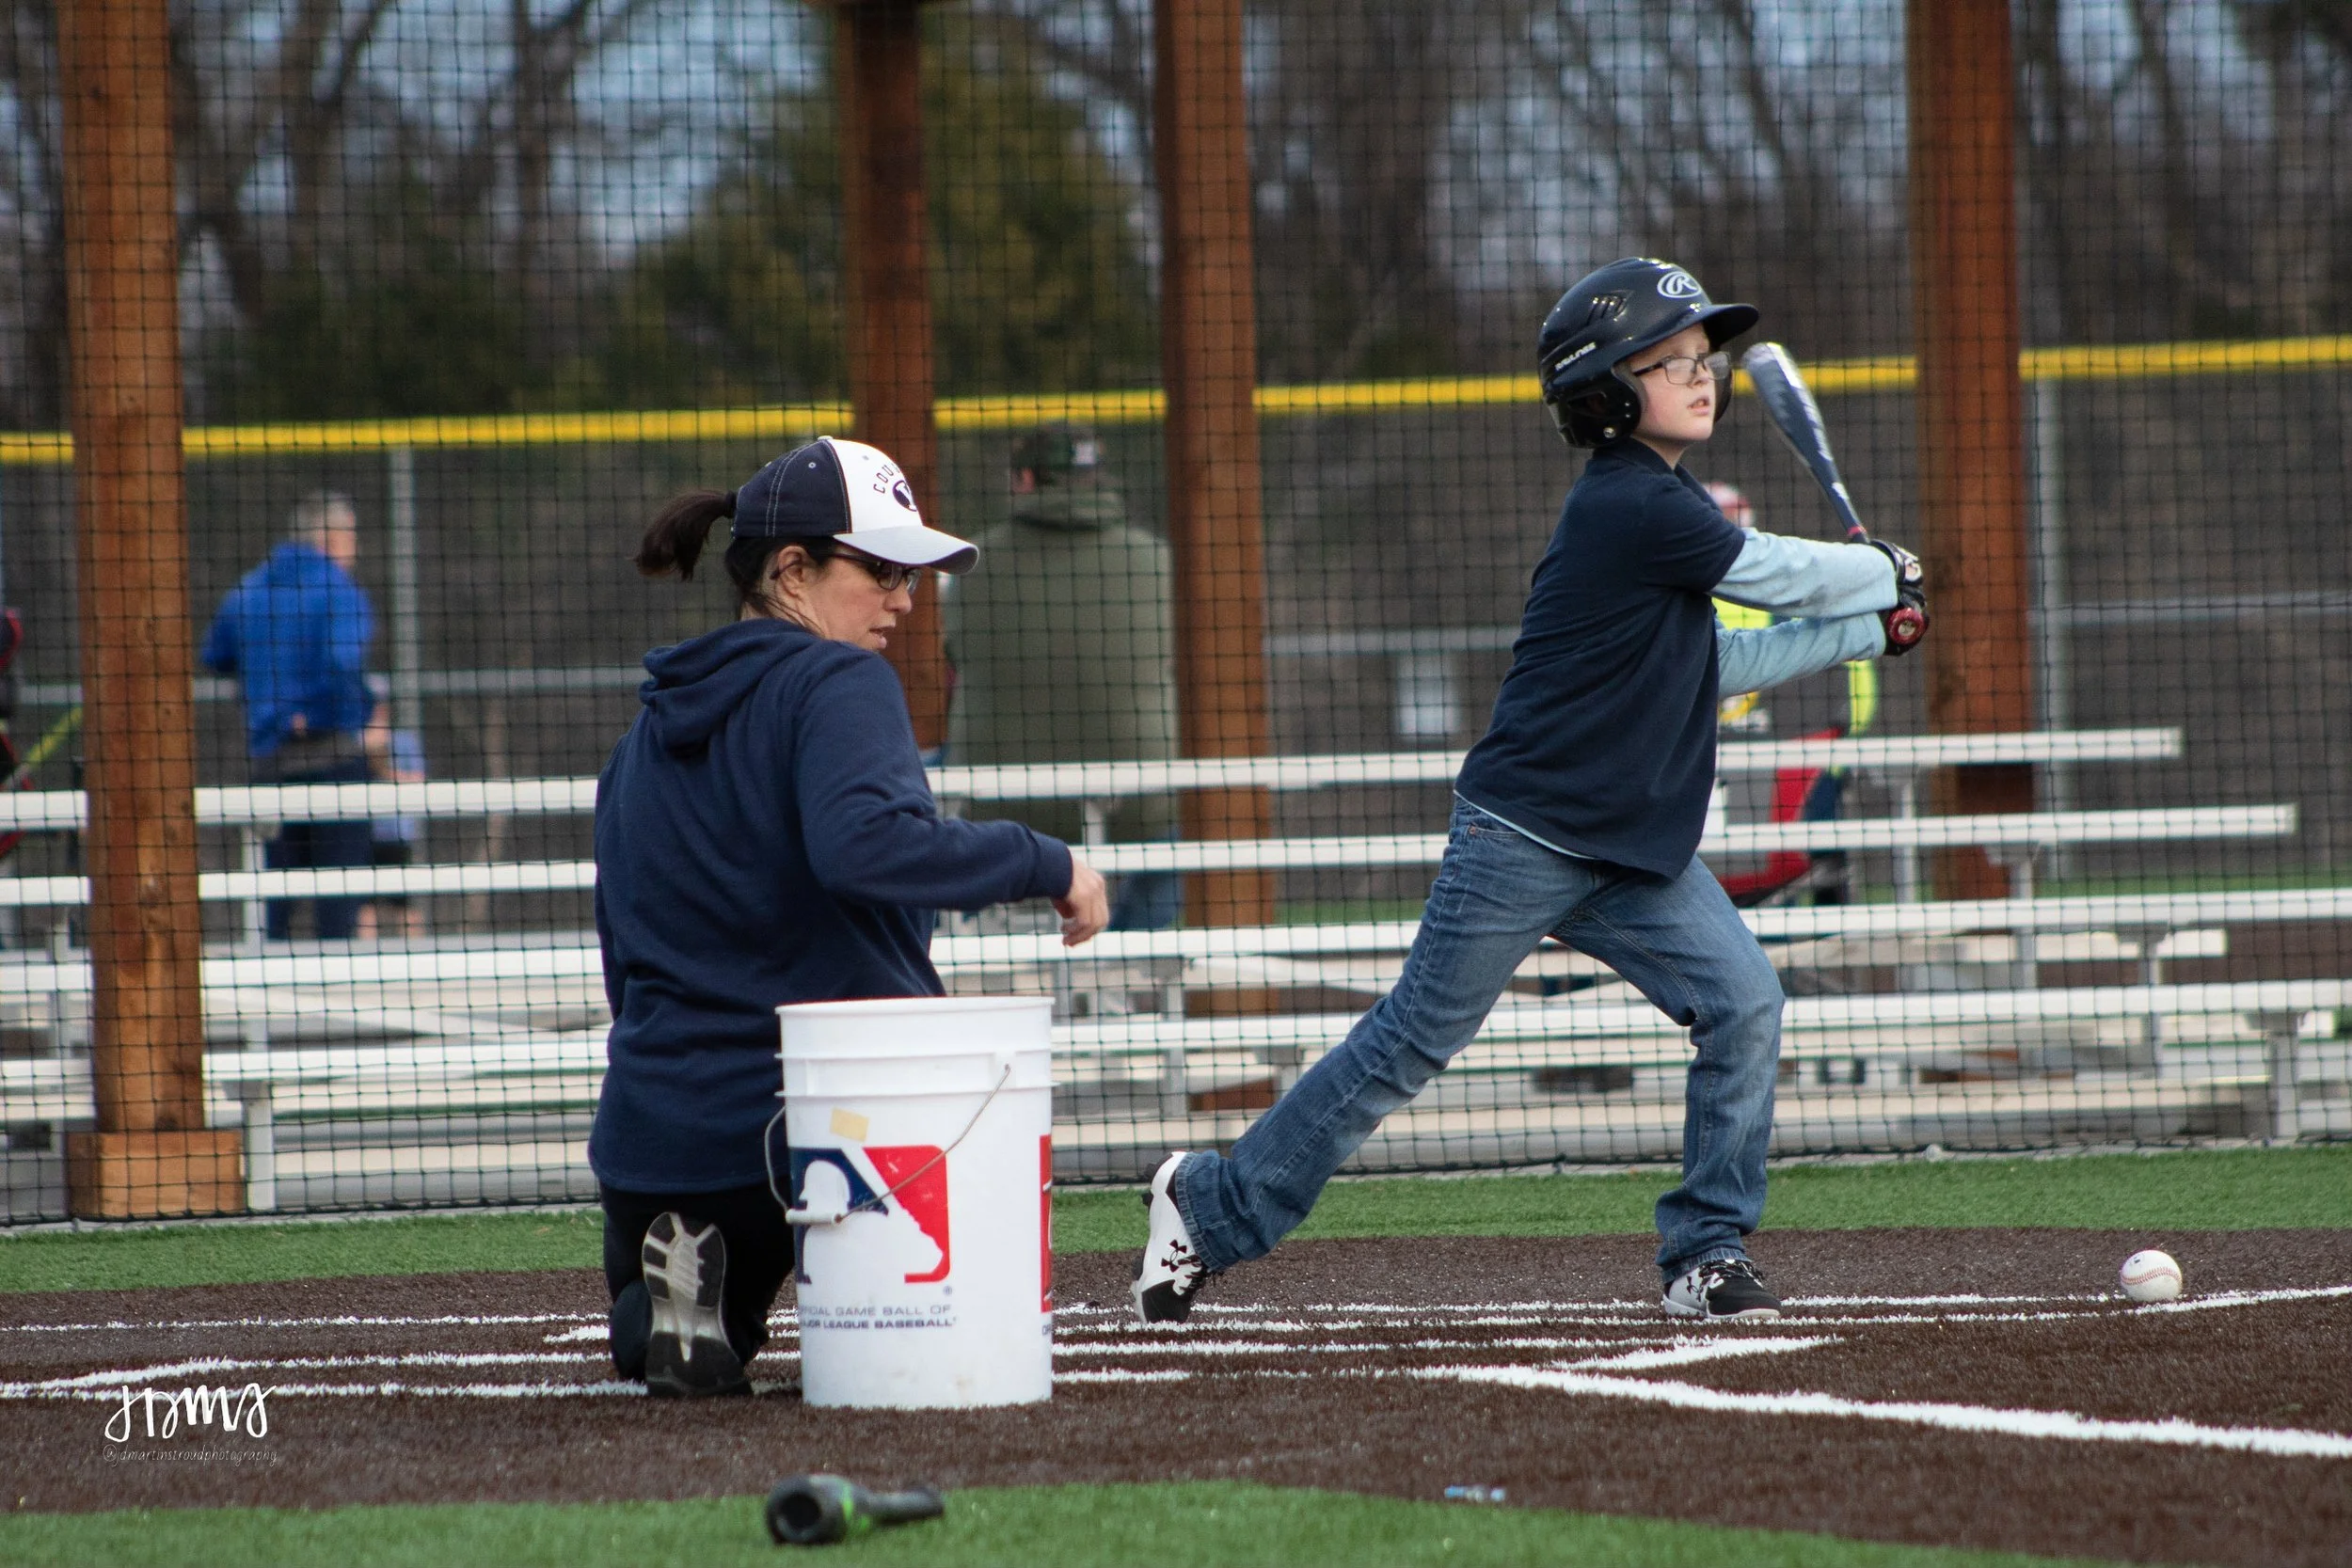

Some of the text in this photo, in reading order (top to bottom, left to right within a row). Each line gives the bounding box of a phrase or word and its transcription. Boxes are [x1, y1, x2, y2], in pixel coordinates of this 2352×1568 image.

[835, 1305, 876, 1316] GAME
[882, 1305, 923, 1316] BALL
[930, 1304, 951, 1315] OF
[823, 1320, 869, 1329] LEAGUE
[874, 1318, 953, 1329] BASEBALL
